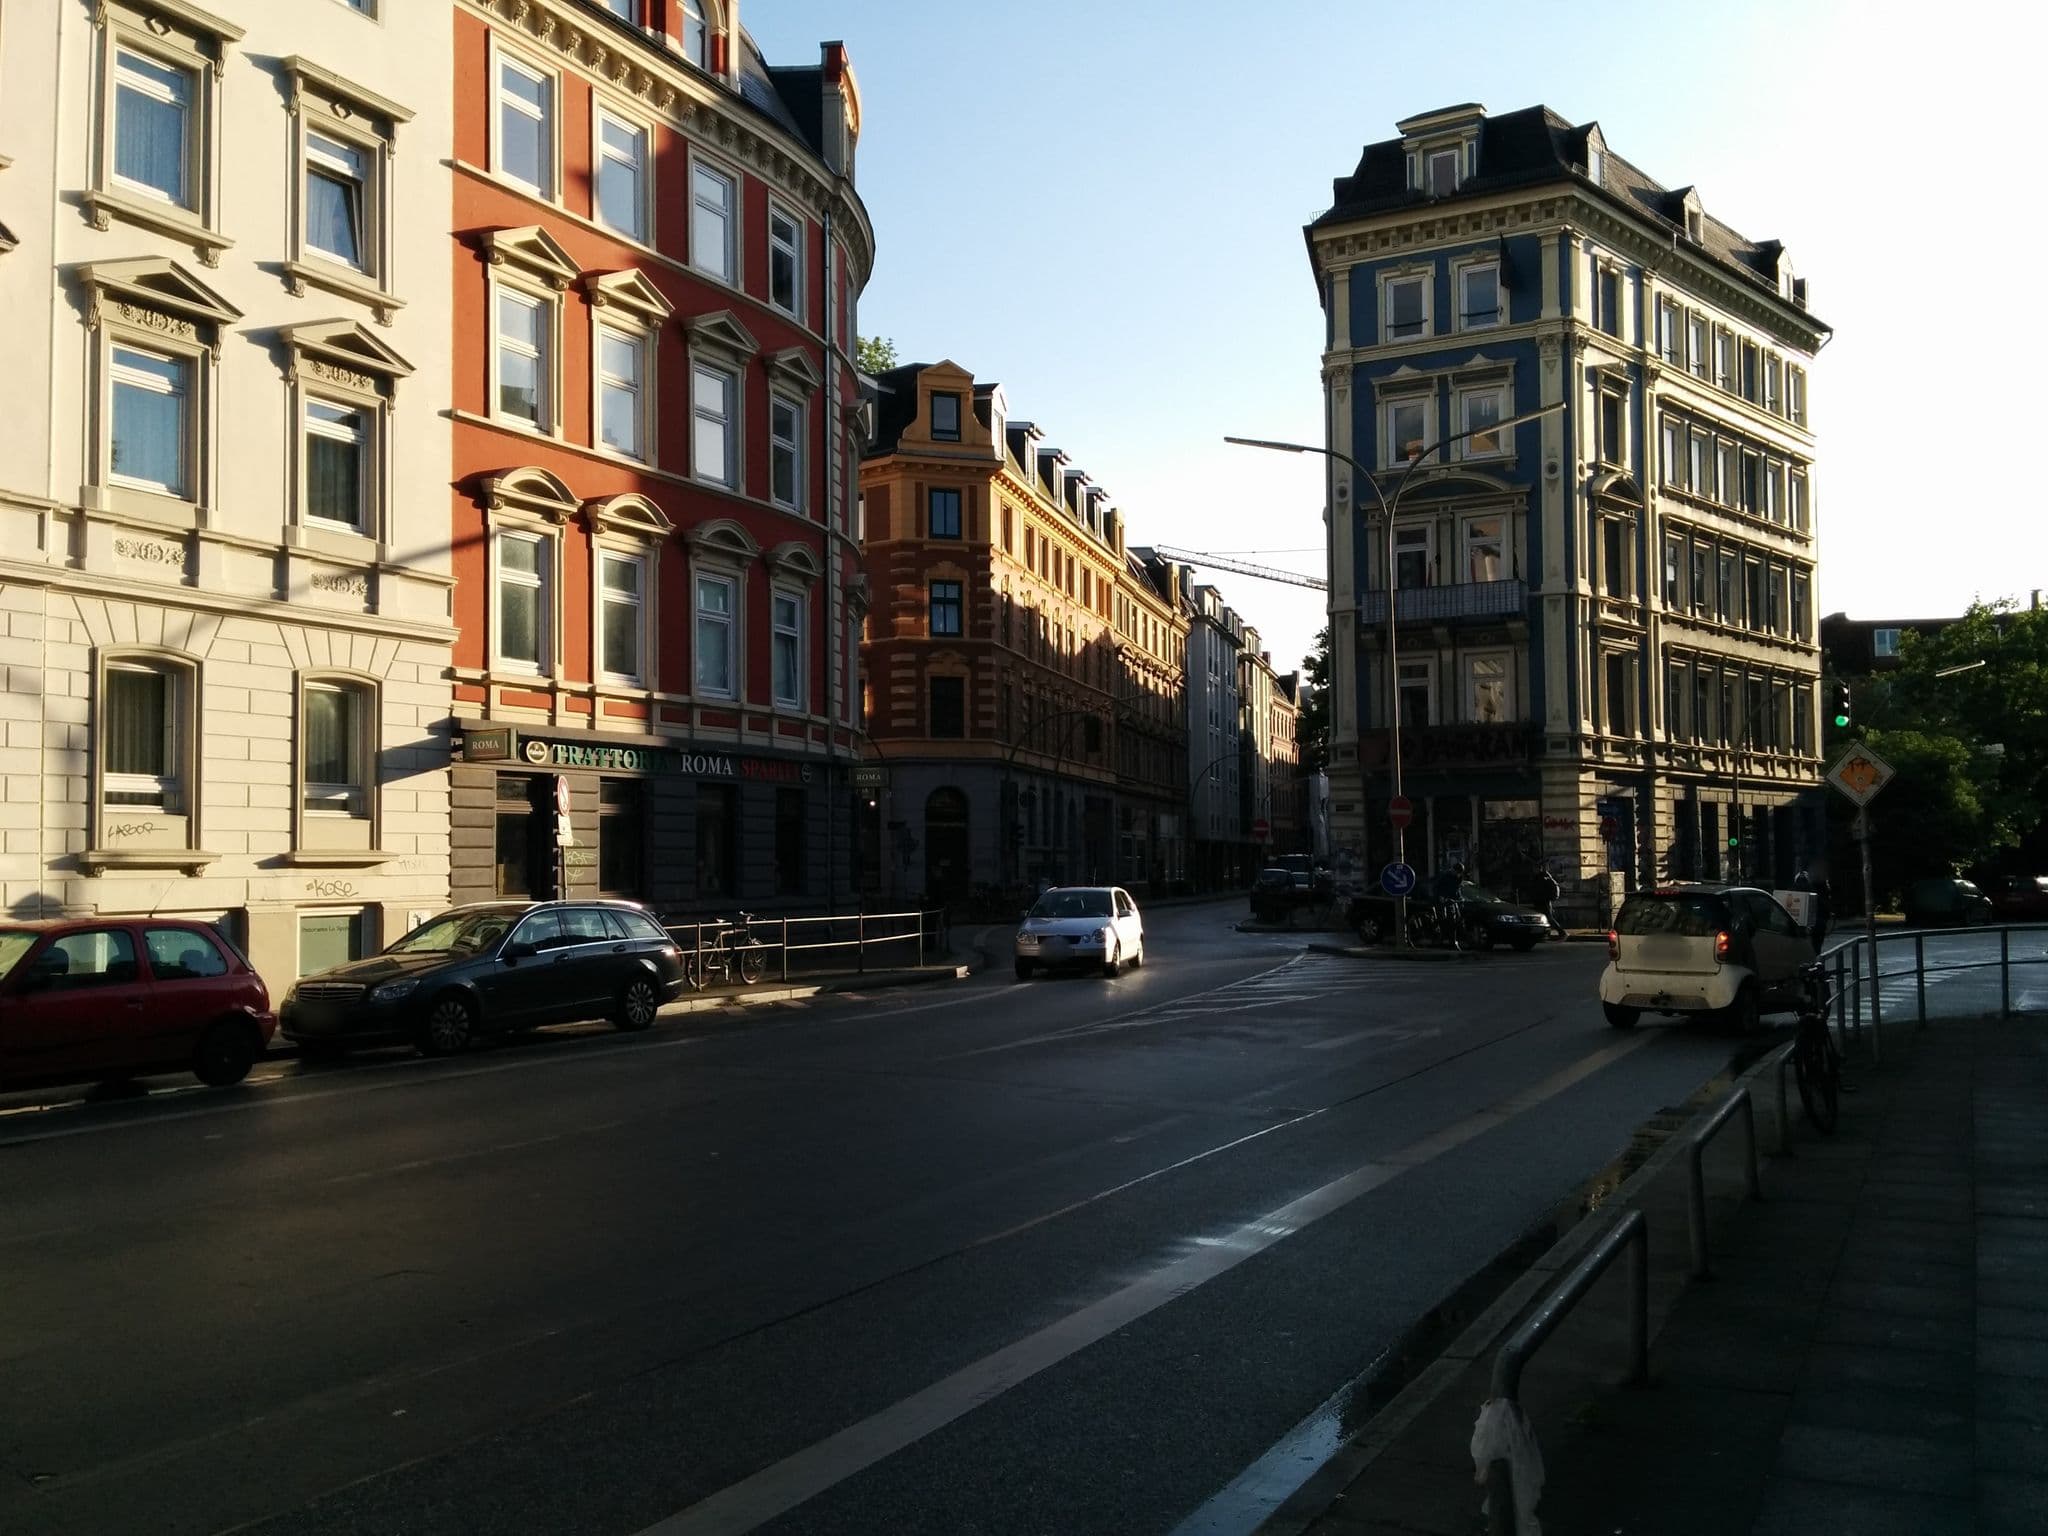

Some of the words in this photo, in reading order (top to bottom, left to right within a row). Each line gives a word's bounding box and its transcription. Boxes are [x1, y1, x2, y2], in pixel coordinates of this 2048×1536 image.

[472, 739, 500, 750] ROMA
[552, 743, 673, 769] TRATTORIA
[681, 754, 734, 776] ROMA
[856, 773, 881, 781] ROMA
